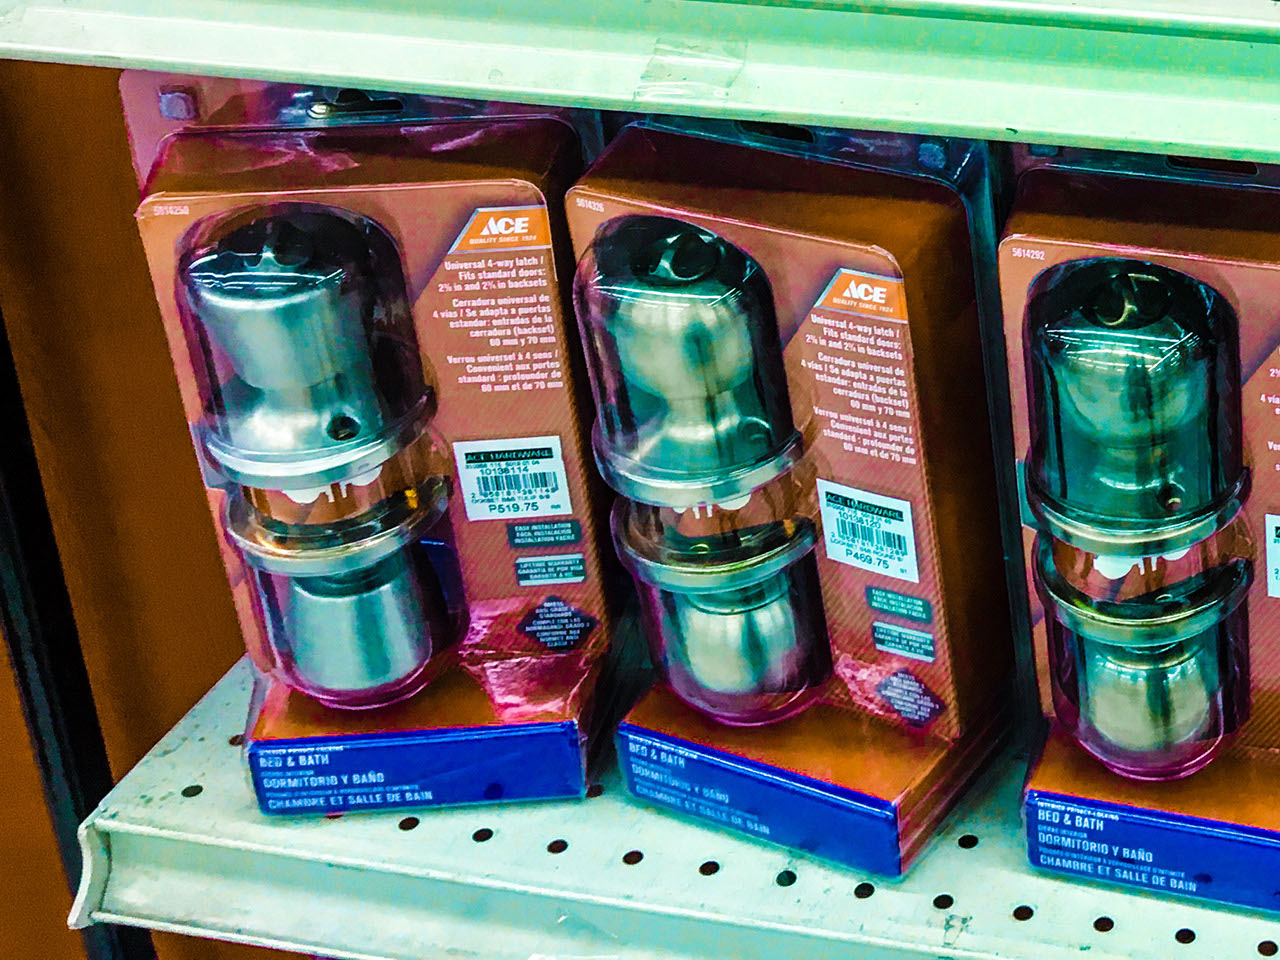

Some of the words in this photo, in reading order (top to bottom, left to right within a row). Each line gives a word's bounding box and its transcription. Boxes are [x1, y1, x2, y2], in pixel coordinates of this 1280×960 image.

[481, 217, 530, 235] ACE
[843, 279, 887, 304] ACE
[480, 466, 529, 475] 10138114
[489, 502, 539, 513] P519.75
[846, 549, 889, 569] P469.75
[1038, 809, 1059, 824] BED
[1063, 814, 1072, 826] &
[1075, 816, 1104, 831] BATH
[1038, 832, 1108, 855] DORMITORIO
[1112, 845, 1119, 856] Y
[1122, 846, 1153, 863] BAÑO
[1040, 854, 1094, 873] CHAMBRE
[1097, 864, 1110, 875] ET
[1114, 868, 1148, 884] SALLE
[1151, 873, 1165, 886] DE
[1170, 877, 1197, 892] BAIN
